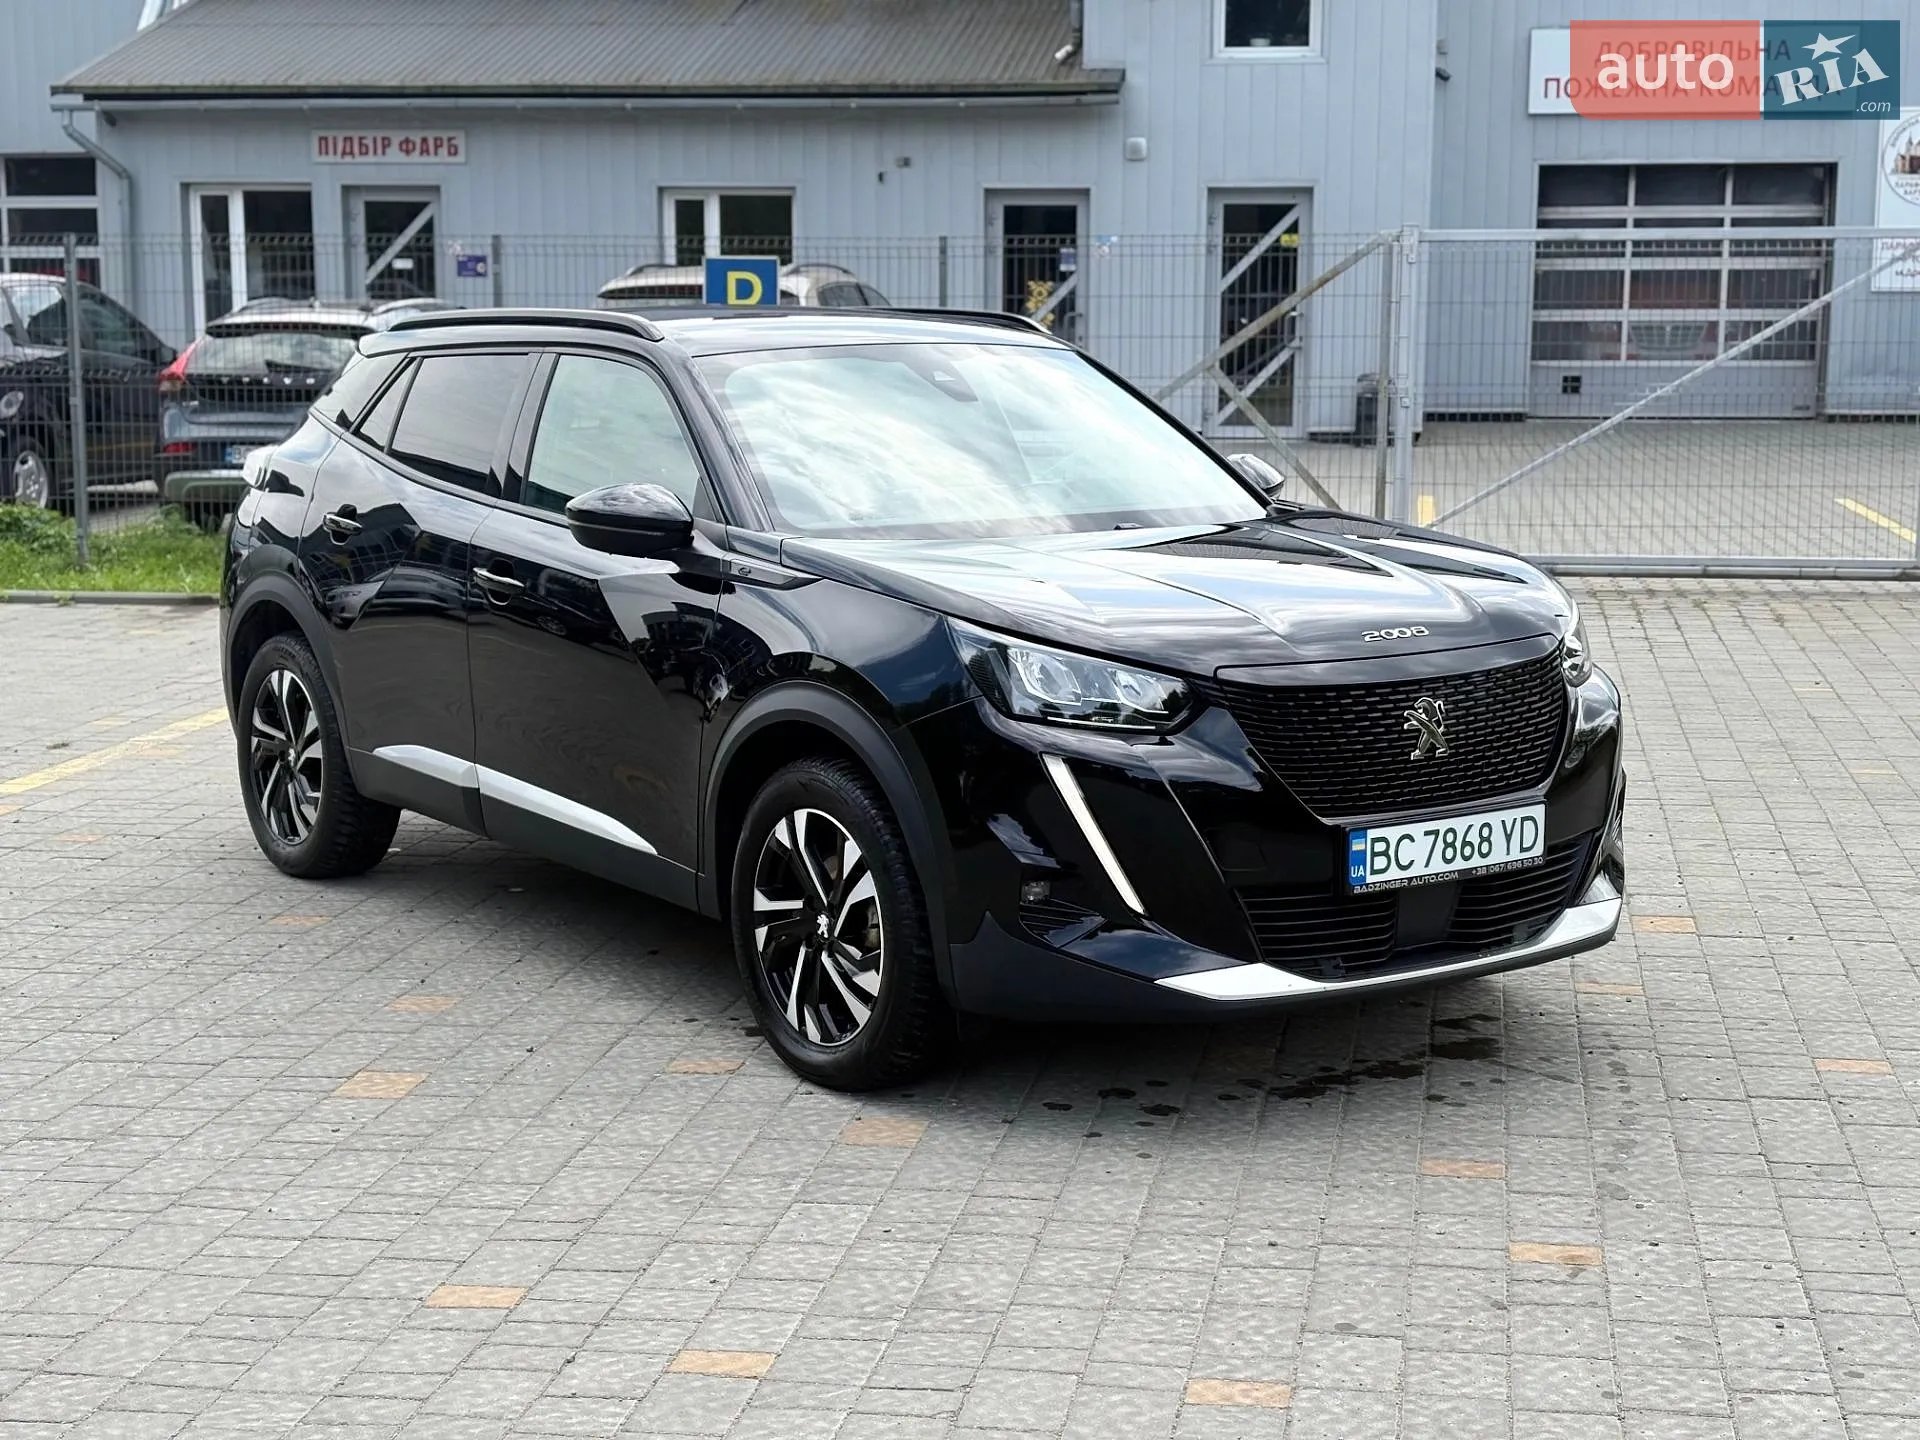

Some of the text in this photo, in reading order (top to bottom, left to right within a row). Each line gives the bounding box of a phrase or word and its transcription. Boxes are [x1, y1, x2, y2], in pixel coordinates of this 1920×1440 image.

[318, 135, 459, 159] ПІДБІР ФАРБ
[727, 270, 763, 305] D
[1361, 626, 1429, 642] 2008
[1369, 815, 1539, 876] BC 7868 YD
[1351, 865, 1365, 878] UA
